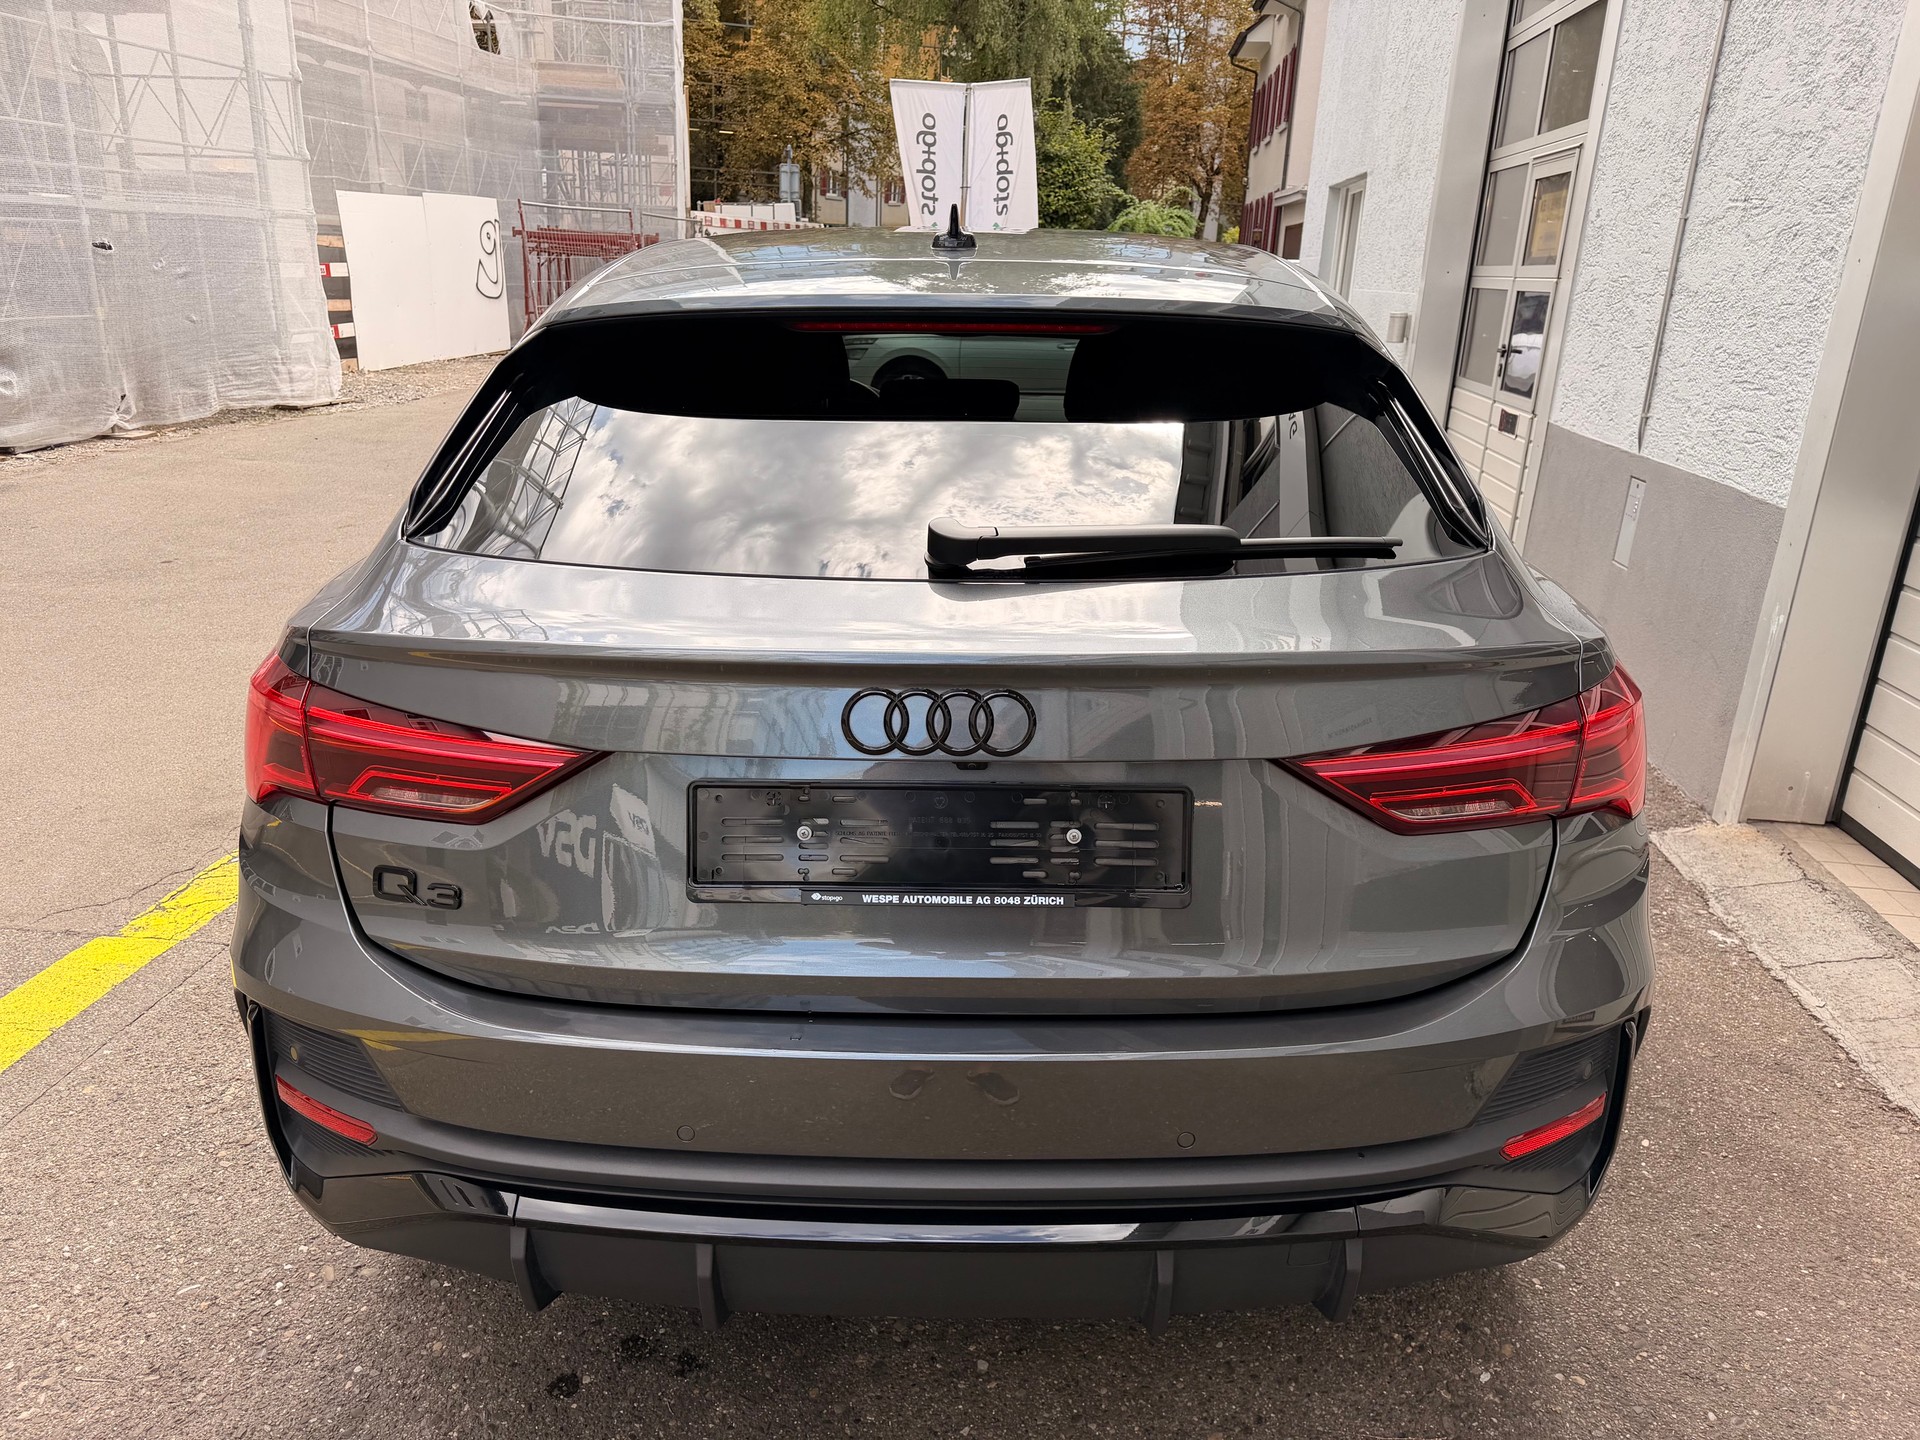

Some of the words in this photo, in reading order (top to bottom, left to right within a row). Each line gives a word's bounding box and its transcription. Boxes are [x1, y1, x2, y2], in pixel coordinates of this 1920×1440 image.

[993, 114, 1014, 216] stop+go
[372, 864, 463, 910] Q3
[862, 894, 900, 904] WESPE
[902, 895, 973, 905] AUTOMOBILE
[976, 896, 991, 905] AG
[993, 896, 1021, 905] 8048
[1023, 894, 1064, 906] ZÜRICH
